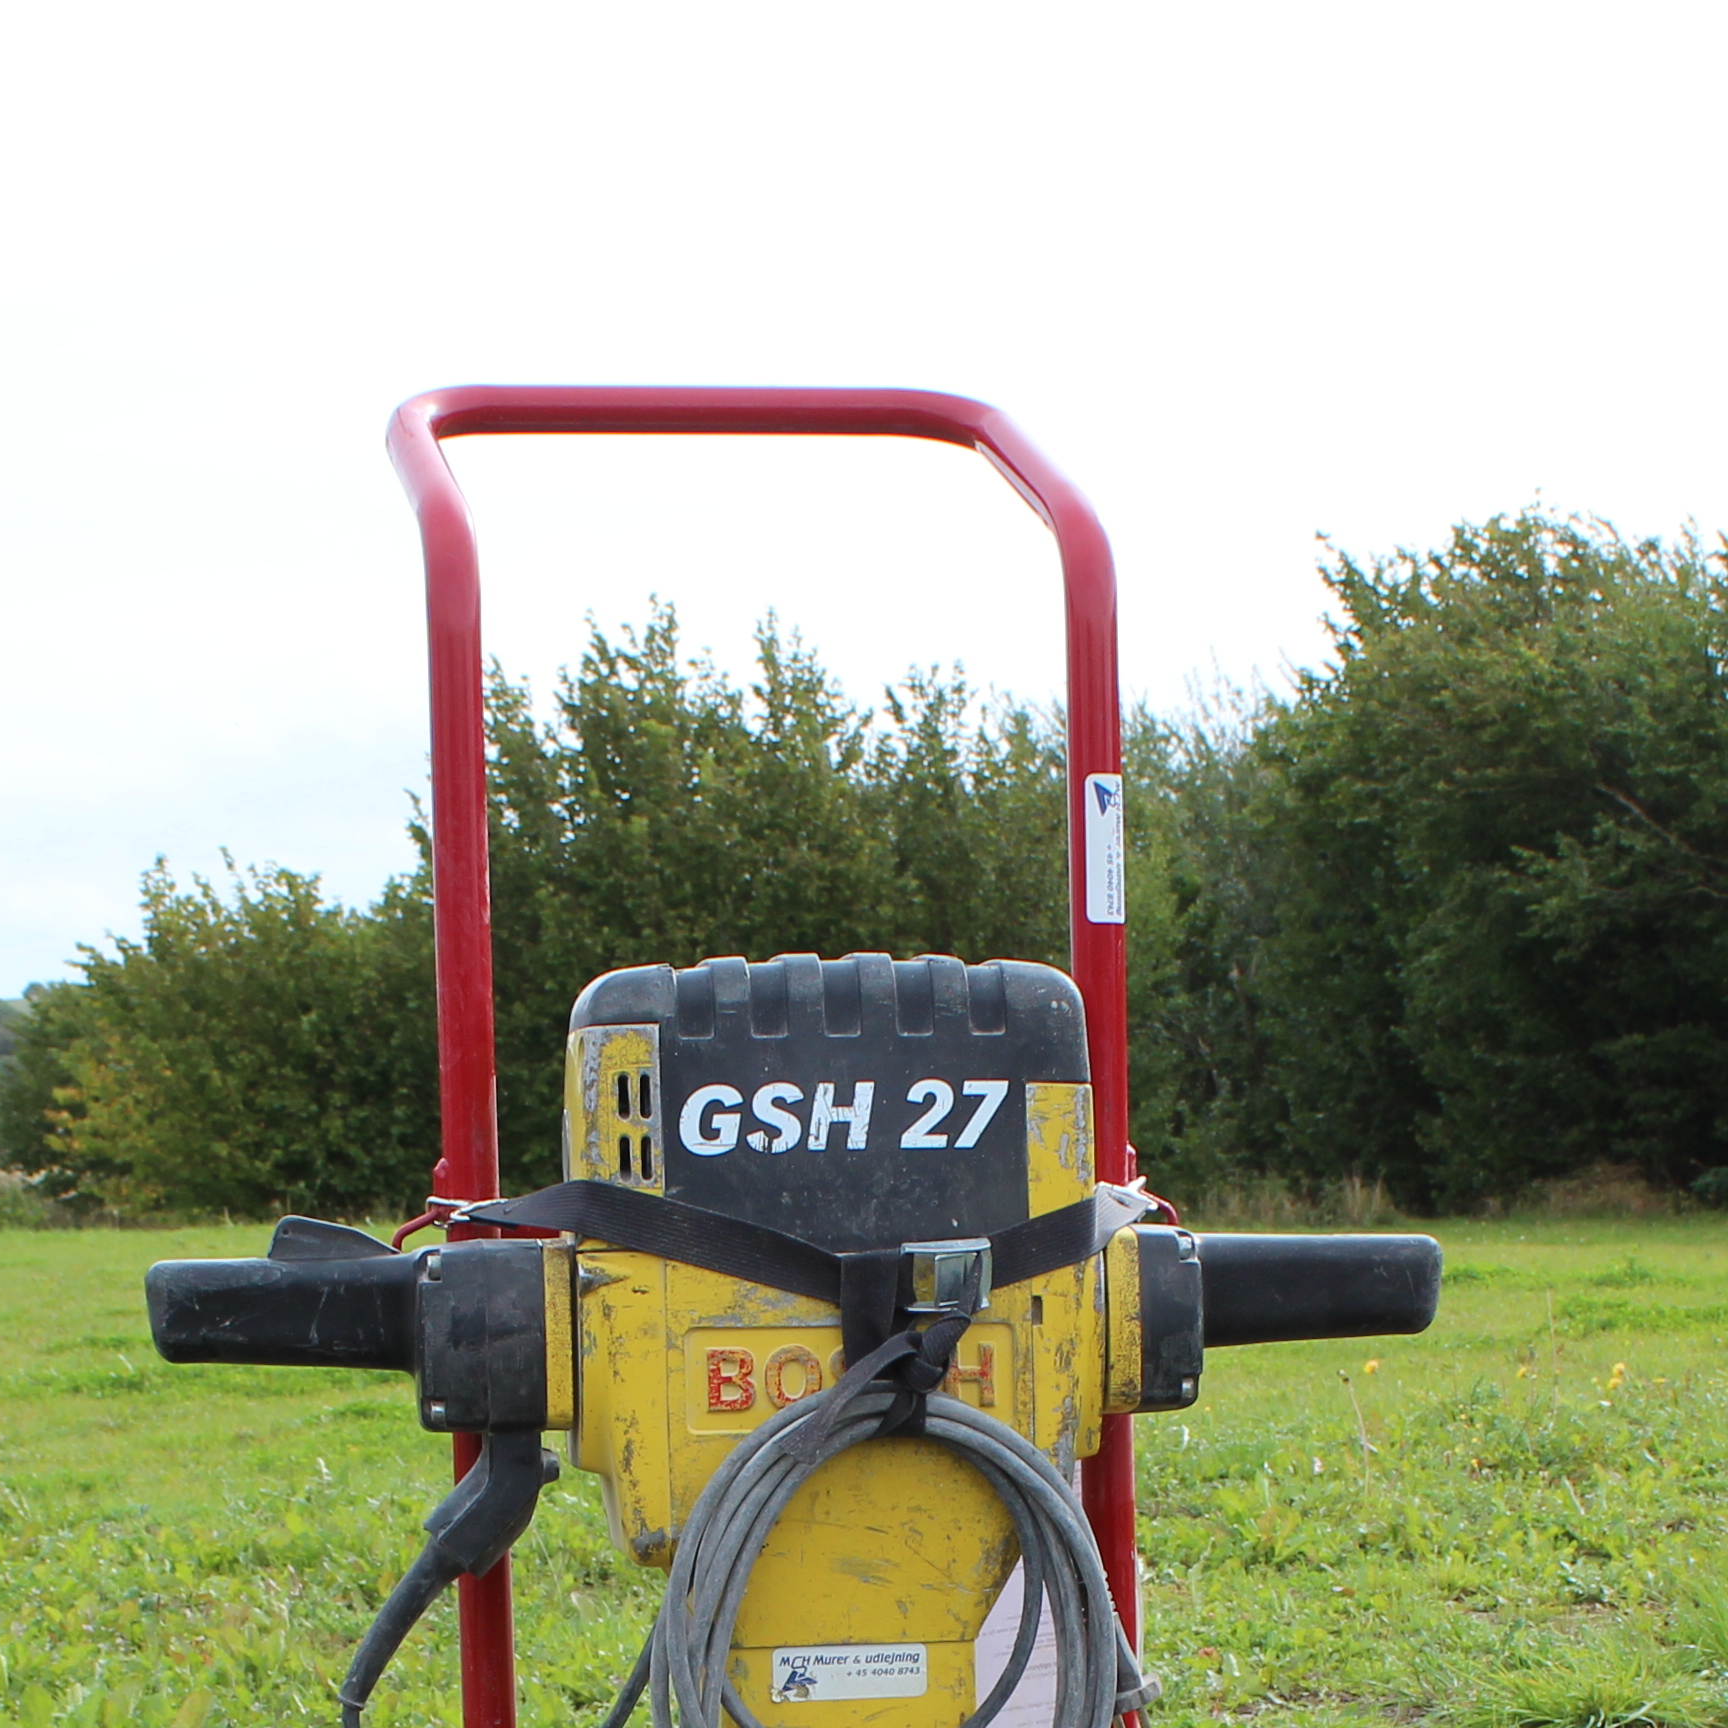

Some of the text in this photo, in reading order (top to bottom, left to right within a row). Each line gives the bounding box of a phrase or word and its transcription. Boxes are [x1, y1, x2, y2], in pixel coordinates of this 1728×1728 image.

[1106, 852, 1113, 865] 45
[678, 1079, 1010, 1156] GSH 27
[707, 1344, 996, 1412] BOH
[779, 1651, 920, 1669] MCH Murer & udlejning
[856, 1668, 868, 1677] 45
[871, 1668, 895, 1676] 4040
[897, 1667, 920, 1675] 8743
